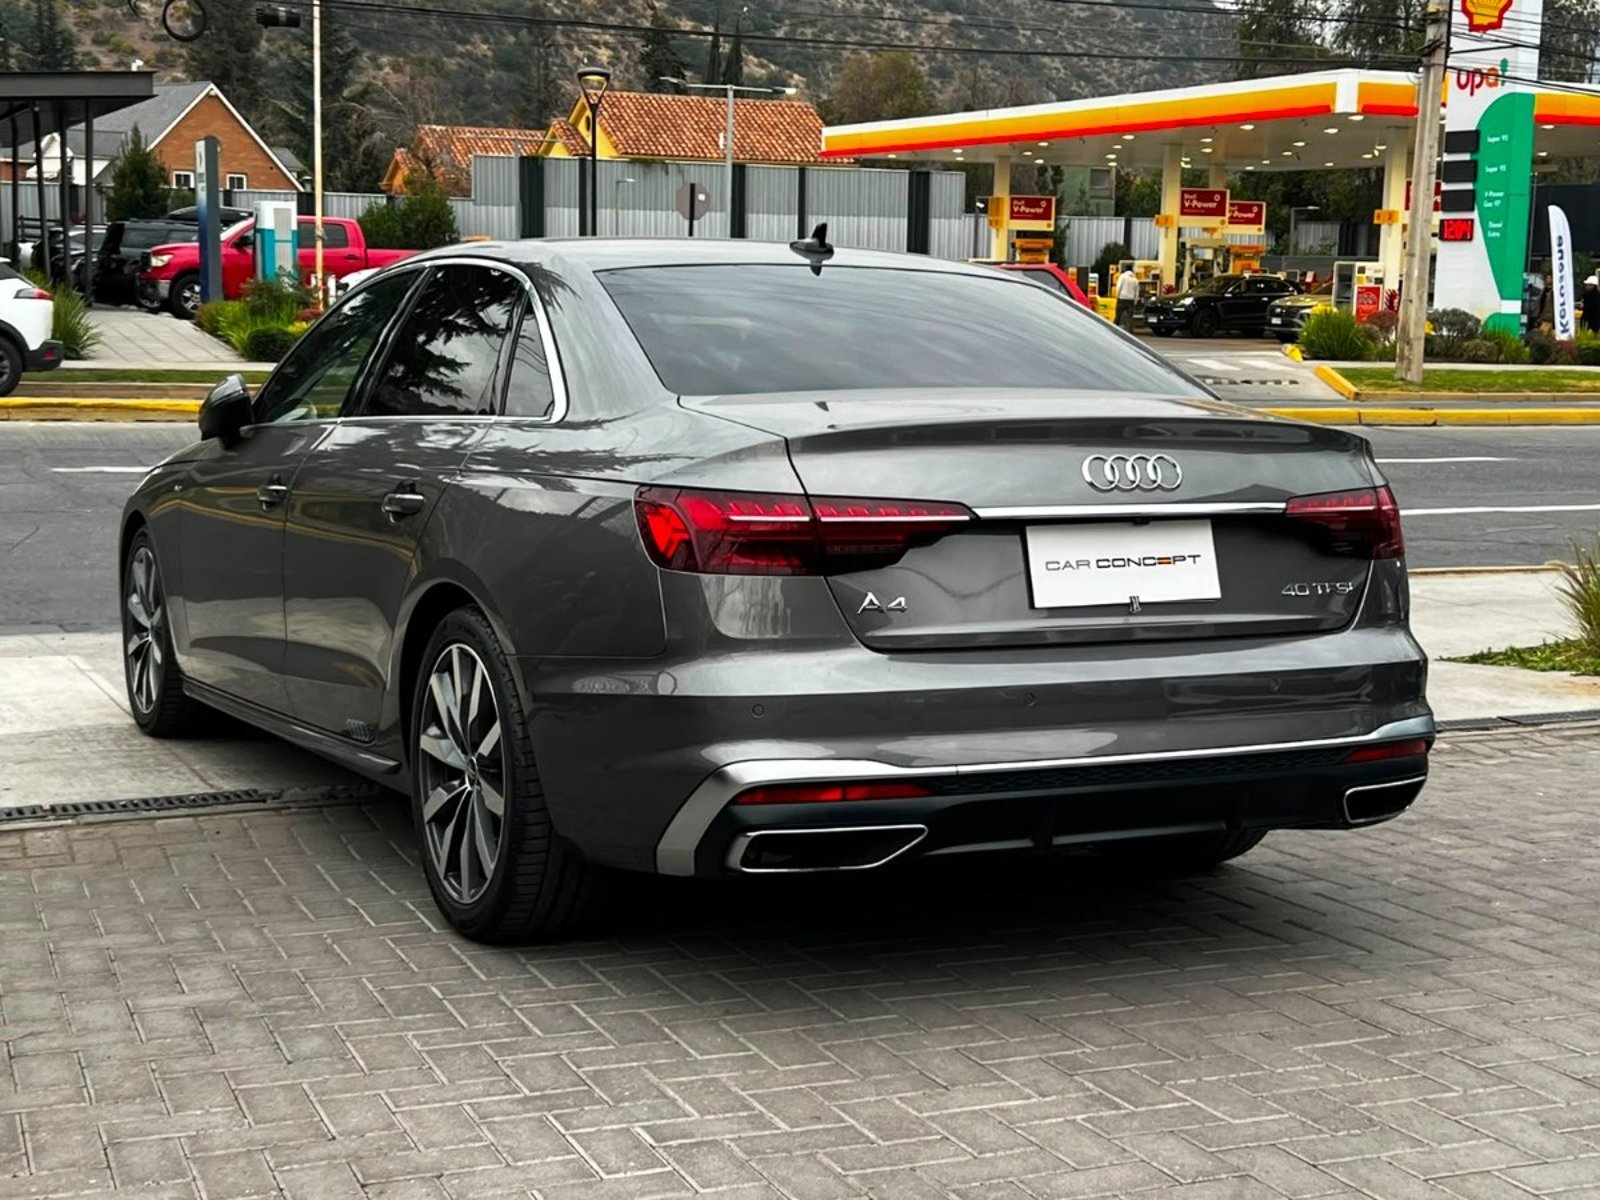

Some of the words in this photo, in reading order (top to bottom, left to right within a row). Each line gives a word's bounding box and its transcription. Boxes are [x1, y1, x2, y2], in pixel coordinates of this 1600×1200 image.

[1012, 205, 1044, 214] V-Power
[1183, 199, 1218, 208] V-Power
[1045, 559, 1091, 572] CAR
[1095, 554, 1201, 569] CONCEPT
[1281, 583, 1309, 596] 40
[1312, 581, 1354, 595] TFSI
[856, 591, 908, 615] A4
